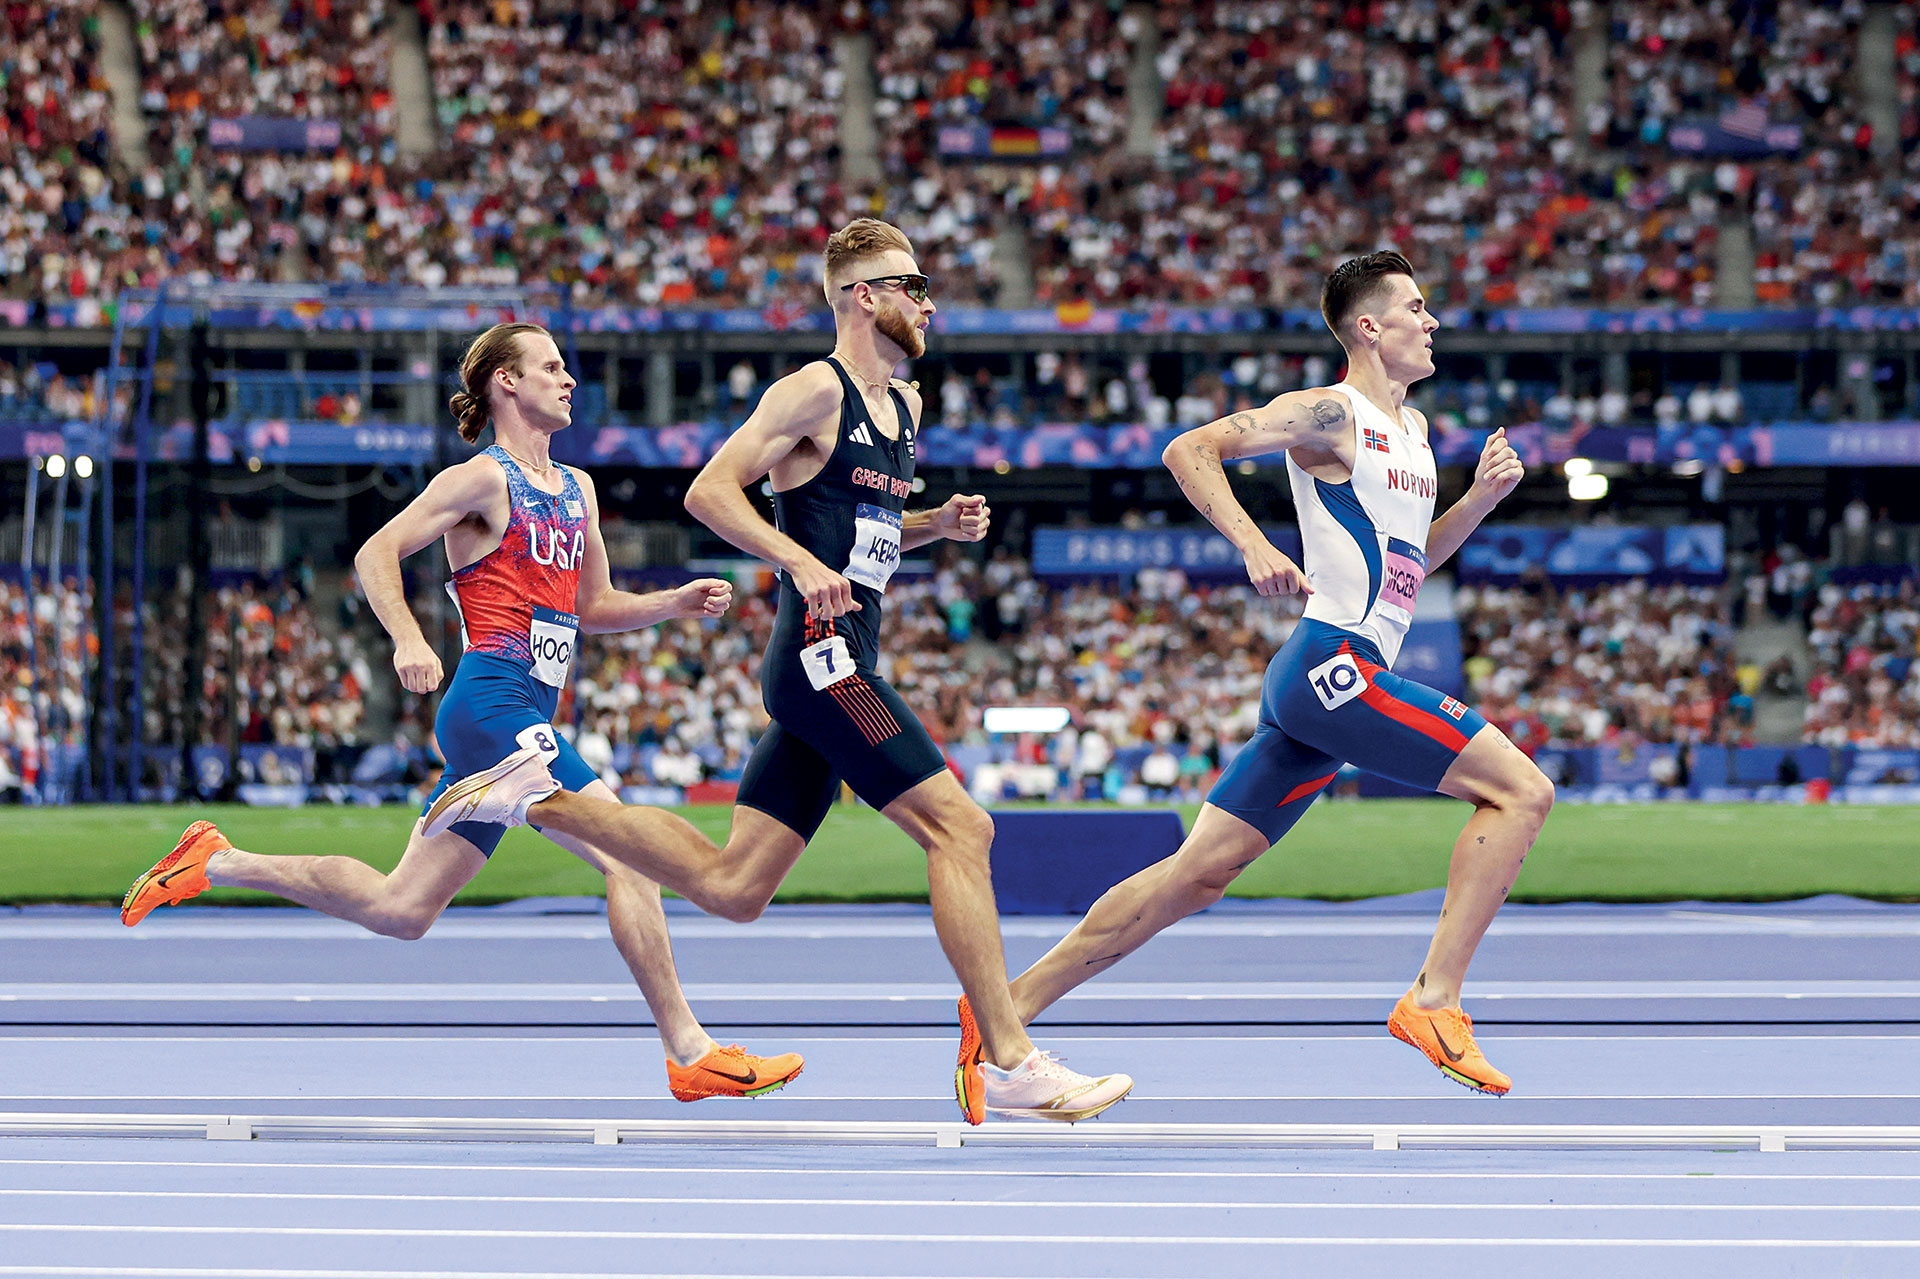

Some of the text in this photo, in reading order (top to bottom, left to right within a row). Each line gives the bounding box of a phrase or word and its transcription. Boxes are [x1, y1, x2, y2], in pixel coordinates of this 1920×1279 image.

[852, 466, 889, 492] GREAT
[529, 522, 585, 571] USA
[1066, 534, 1173, 567] PARIS
[1387, 566, 1418, 599] INGEB
[554, 614, 571, 625] PARIS
[815, 647, 836, 675] 7
[1315, 664, 1358, 701] 10
[534, 732, 556, 752] 8
[1063, 1082, 1099, 1102] BROOKS
